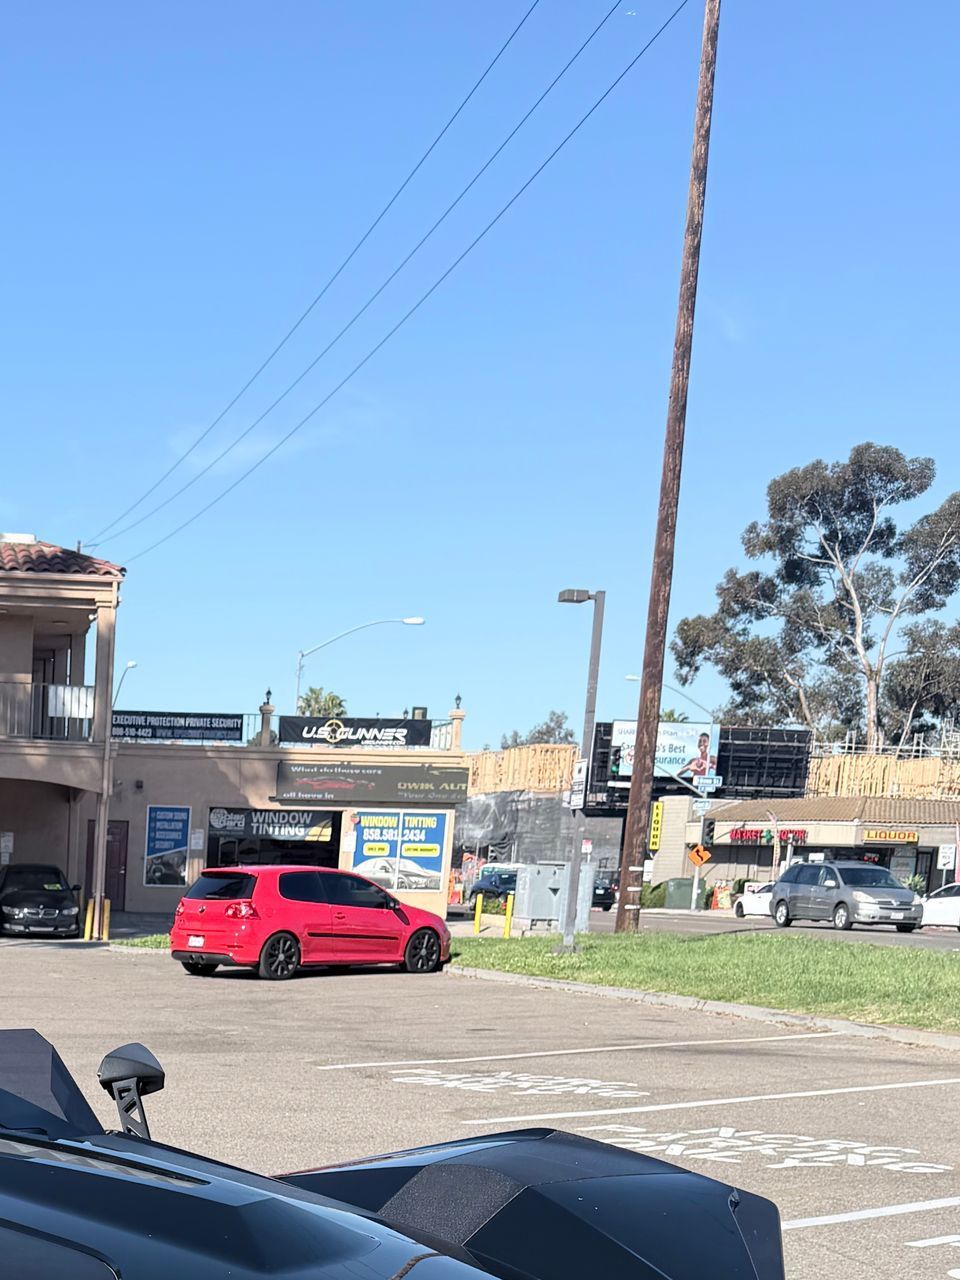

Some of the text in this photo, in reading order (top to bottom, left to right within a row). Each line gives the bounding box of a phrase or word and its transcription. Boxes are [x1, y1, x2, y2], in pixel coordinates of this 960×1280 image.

[112, 714, 242, 728] EXECUTIVE PROTECTION PRIVATE SECURITY
[668, 743, 686, 754] Best
[251, 811, 313, 824] WINDOW
[360, 815, 437, 828] WINDOW TINTING
[251, 823, 305, 836] TINTING
[651, 804, 660, 847] LIQUOR
[867, 831, 916, 839] LIQUOR
